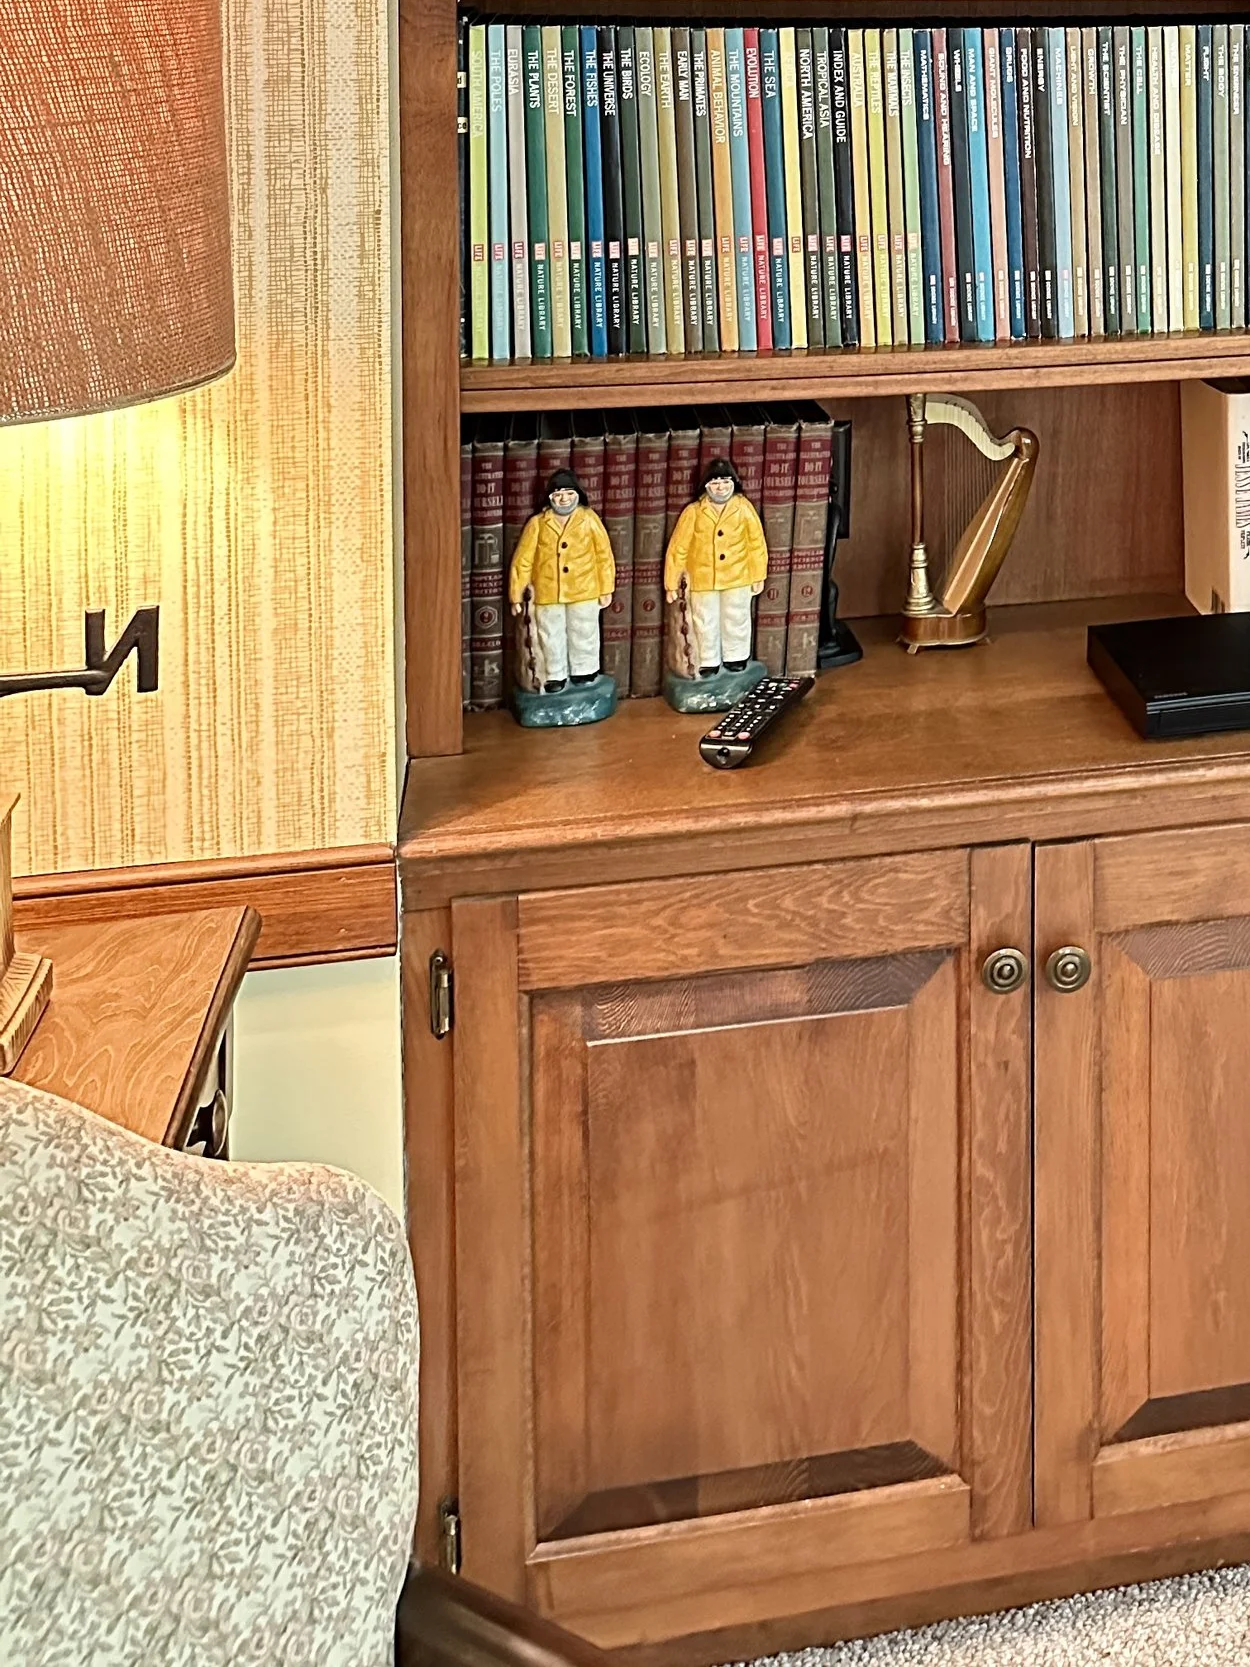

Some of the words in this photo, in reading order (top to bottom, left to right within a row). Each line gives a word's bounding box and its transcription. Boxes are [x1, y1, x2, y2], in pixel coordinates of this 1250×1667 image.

[507, 49, 519, 95] EURASIA
[564, 50, 574, 72] THE
[585, 50, 596, 70] THE
[640, 51, 652, 96] ECOLOGY
[710, 50, 722, 82] ANIMAL
[746, 48, 759, 98] EVOLUTION
[800, 48, 811, 84] NORTH
[833, 50, 843, 83] INDEX
[566, 74, 576, 117] FOREST
[586, 71, 598, 107] FISHES
[834, 86, 844, 106] AND
[712, 84, 726, 144] BEHAVIOR
[802, 88, 813, 140] AMERICA
[836, 108, 846, 143] GUIDE
[536, 264, 544, 295] NATURE
[538, 298, 546, 330] LIBRARY
